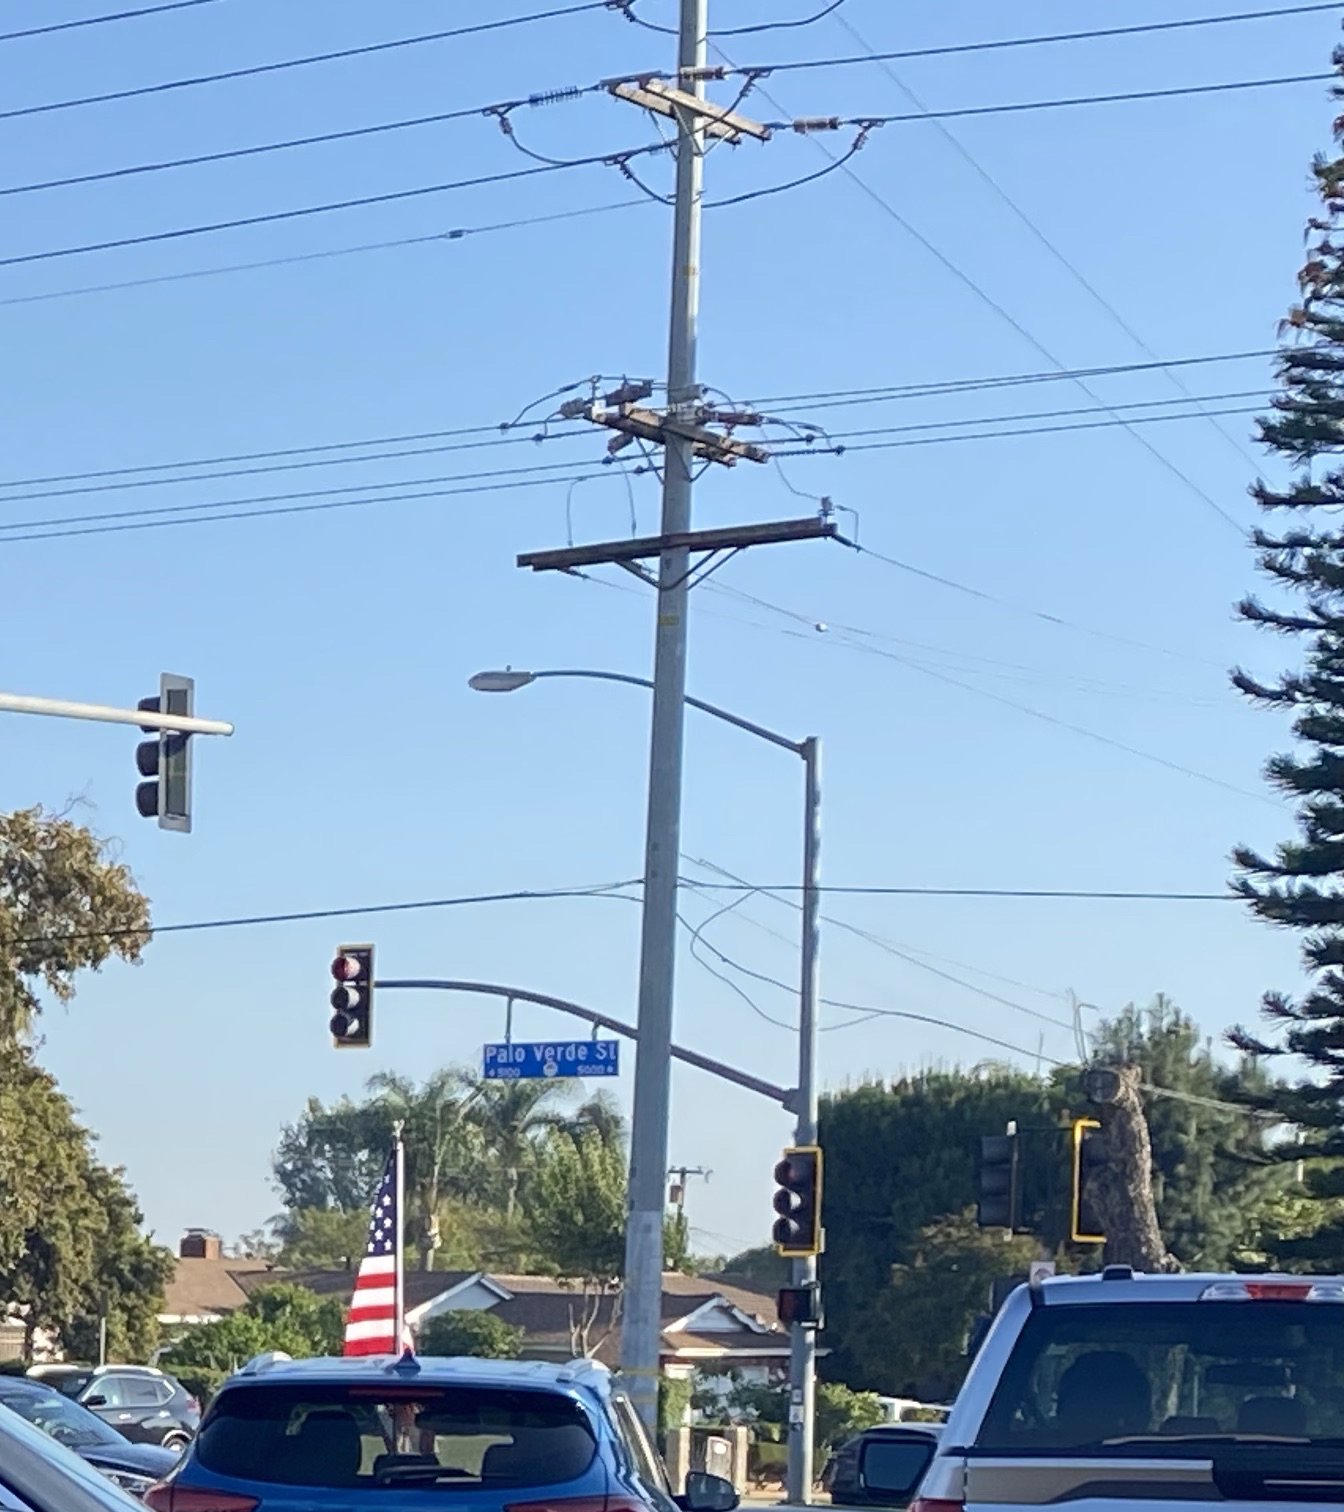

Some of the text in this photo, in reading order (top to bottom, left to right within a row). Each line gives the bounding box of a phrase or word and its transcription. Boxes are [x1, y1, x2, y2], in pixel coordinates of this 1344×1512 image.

[486, 1042, 617, 1064] Palo Verde St
